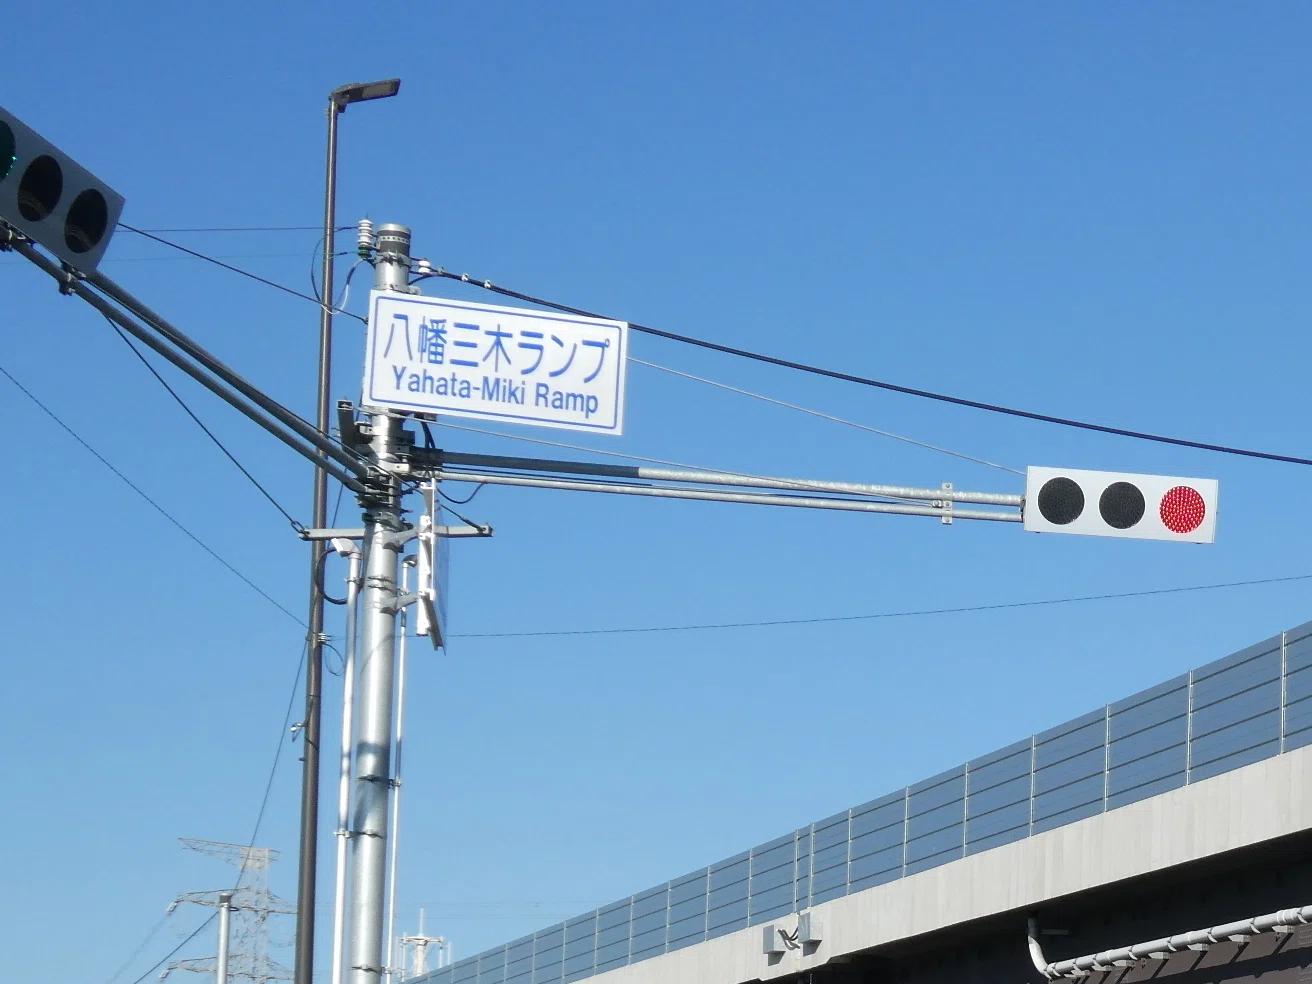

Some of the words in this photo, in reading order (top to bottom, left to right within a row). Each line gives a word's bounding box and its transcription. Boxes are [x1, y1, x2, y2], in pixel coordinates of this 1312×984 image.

[384, 314, 610, 383] 八幡三木ランプ
[392, 365, 526, 405] Yahata-Miki
[535, 383, 598, 419] Ramp
